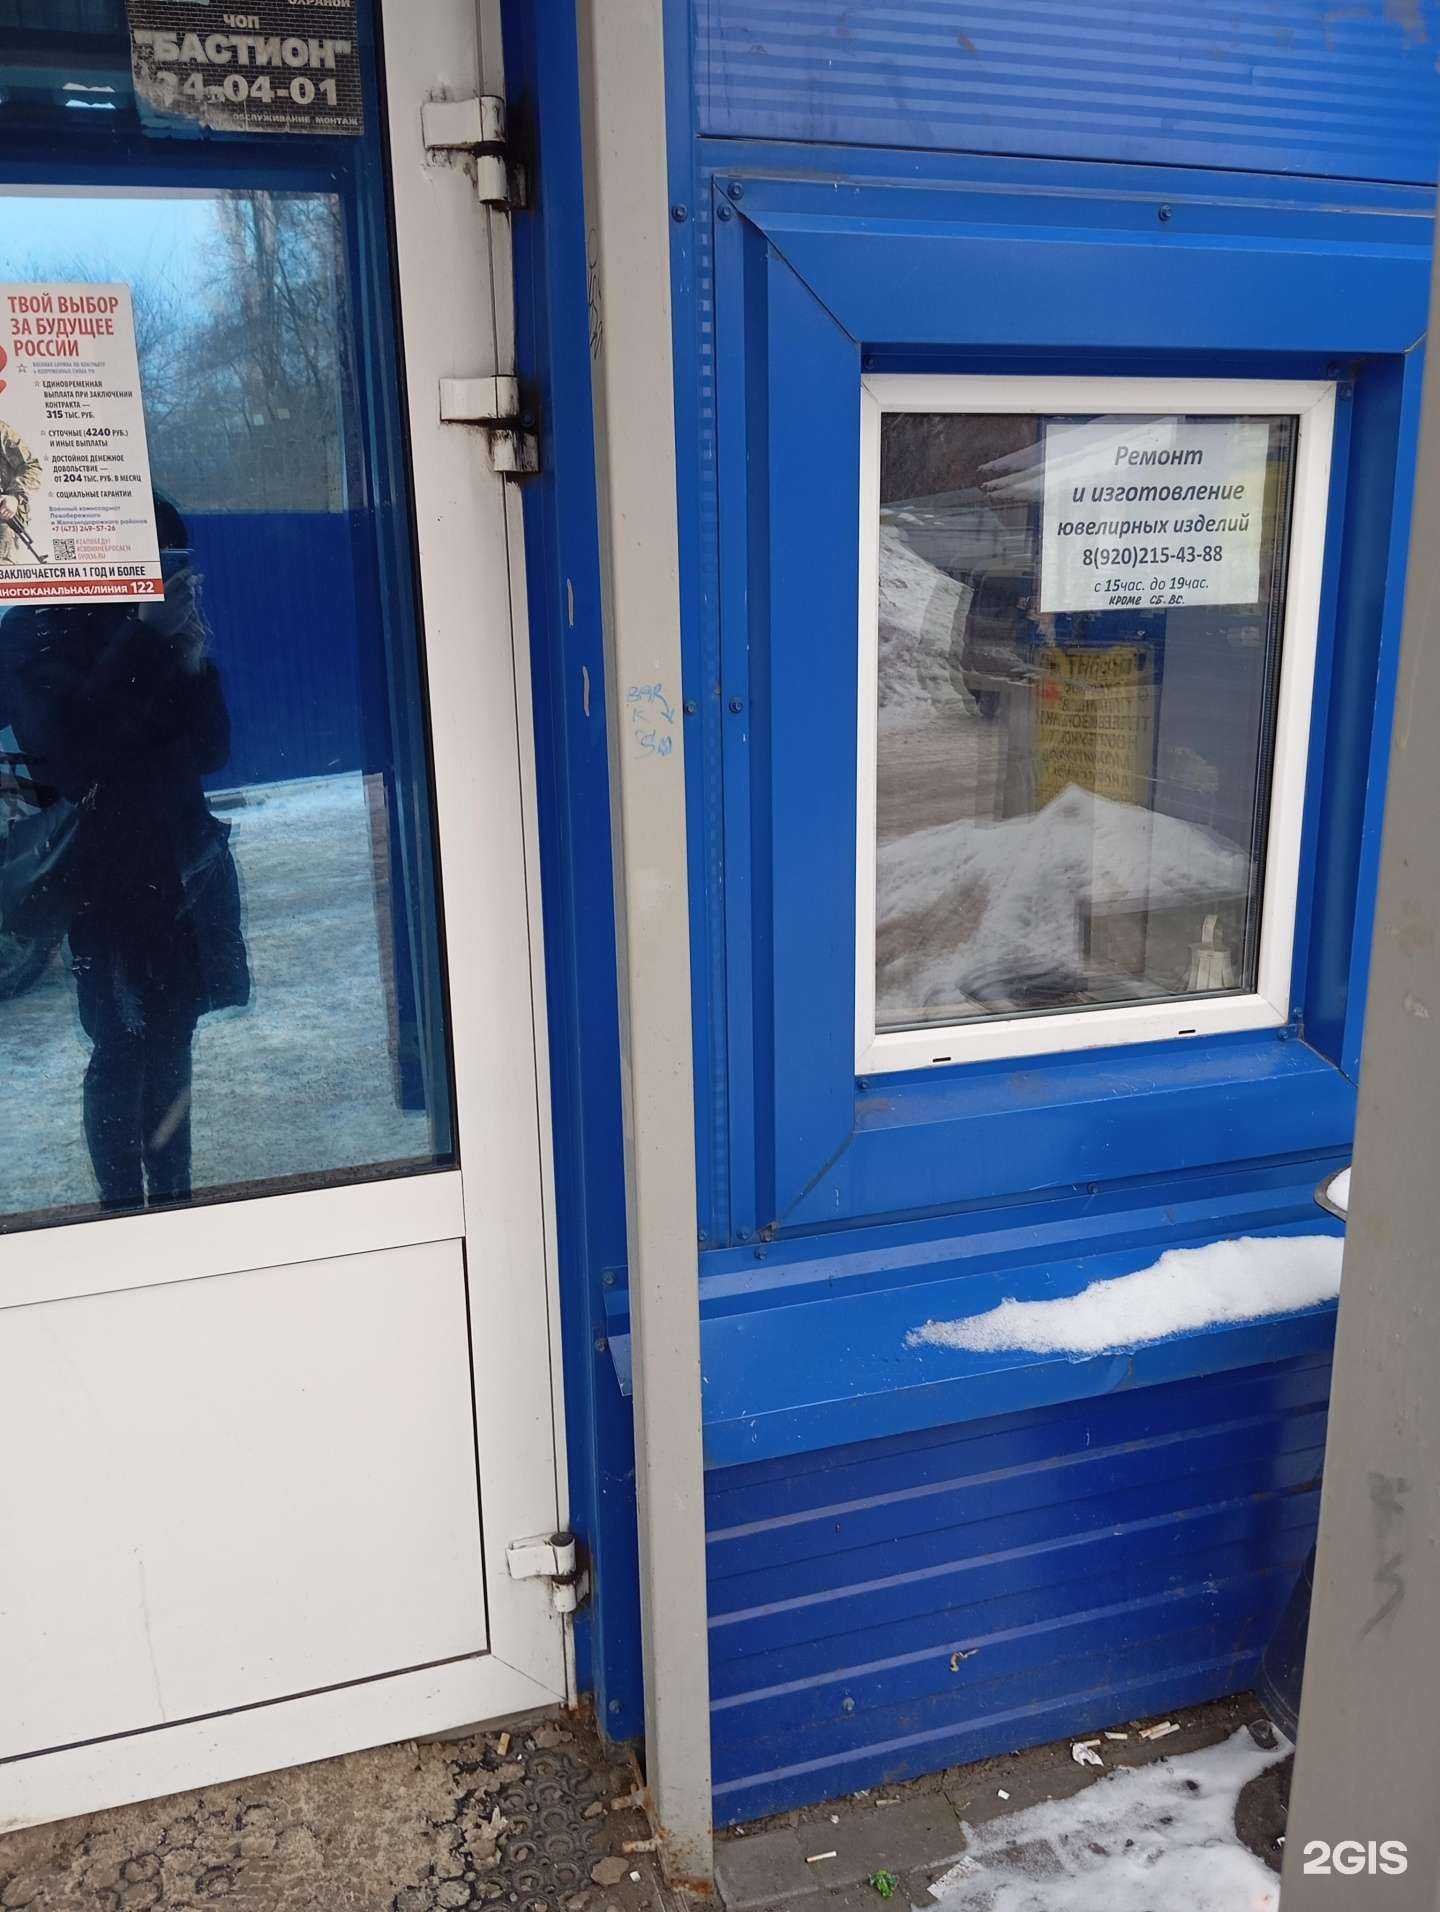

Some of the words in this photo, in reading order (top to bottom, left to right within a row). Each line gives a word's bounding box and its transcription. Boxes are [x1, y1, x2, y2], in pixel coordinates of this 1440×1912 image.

[223, 14, 260, 29] ЧОП
[315, 116, 358, 126] МОНТАЖ
[8, 292, 53, 313] ТВОЙ
[57, 296, 119, 314] ВЫБОР
[10, 318, 33, 335] ЗА
[36, 318, 115, 338] БУДУЩЕЕ
[14, 339, 80, 357] РОССИИ
[42, 380, 103, 389] ЕДИНОВРЕМЕННАЯ
[44, 390, 74, 399] ВЫПЛАТА
[75, 390, 89, 399] ПРИ
[90, 390, 133, 399] ЗАКЛЮЧЕНИИ
[45, 401, 81, 409] КОНТРАКТА
[46, 410, 63, 419] 315
[64, 411, 80, 419] ТЫС.
[81, 411, 95, 419] РУБ.
[48, 429, 82, 437] СУТОЧНЫЕ
[83, 428, 111, 437] (4240
[76, 439, 108, 447] ВЫПЛАТЫ
[52, 454, 89, 463] ДОСТОЙНОЕ
[90, 454, 124, 462] ДЕНЕЖНОЕ
[1114, 446, 1204, 466] Ремонт
[53, 465, 98, 473] ДОВОЛЬСТВИЕ
[63, 473, 82, 482] 204
[83, 474, 99, 482] ТЫС.
[100, 474, 113, 482] РУБ.
[120, 474, 142, 482] МЕСЯЦ
[56, 490, 99, 499] СОЦИАЛЬНЫЕ
[100, 489, 132, 498] ГАРАНТИИ
[1072, 486, 1085, 502] и
[1091, 484, 1245, 501] изготовление
[1057, 517, 1168, 539] ювелирных
[1173, 512, 1250, 533] изделий
[1083, 545, 1223, 568] 8(920)215-43-88
[0, 567, 65, 579] ЗАКЛЮЧАЕТСЯ
[68, 567, 80, 577] НА
[83, 567, 87, 577] 1
[90, 566, 107, 578] ГОД
[109, 566, 115, 576] И
[118, 566, 146, 576] БОЛЕЕ
[130, 581, 155, 593] 122
[1094, 582, 1101, 592] с
[1104, 578, 1145, 592] 15час.
[1149, 577, 1166, 590] до
[1169, 576, 1209, 590] 19час.
